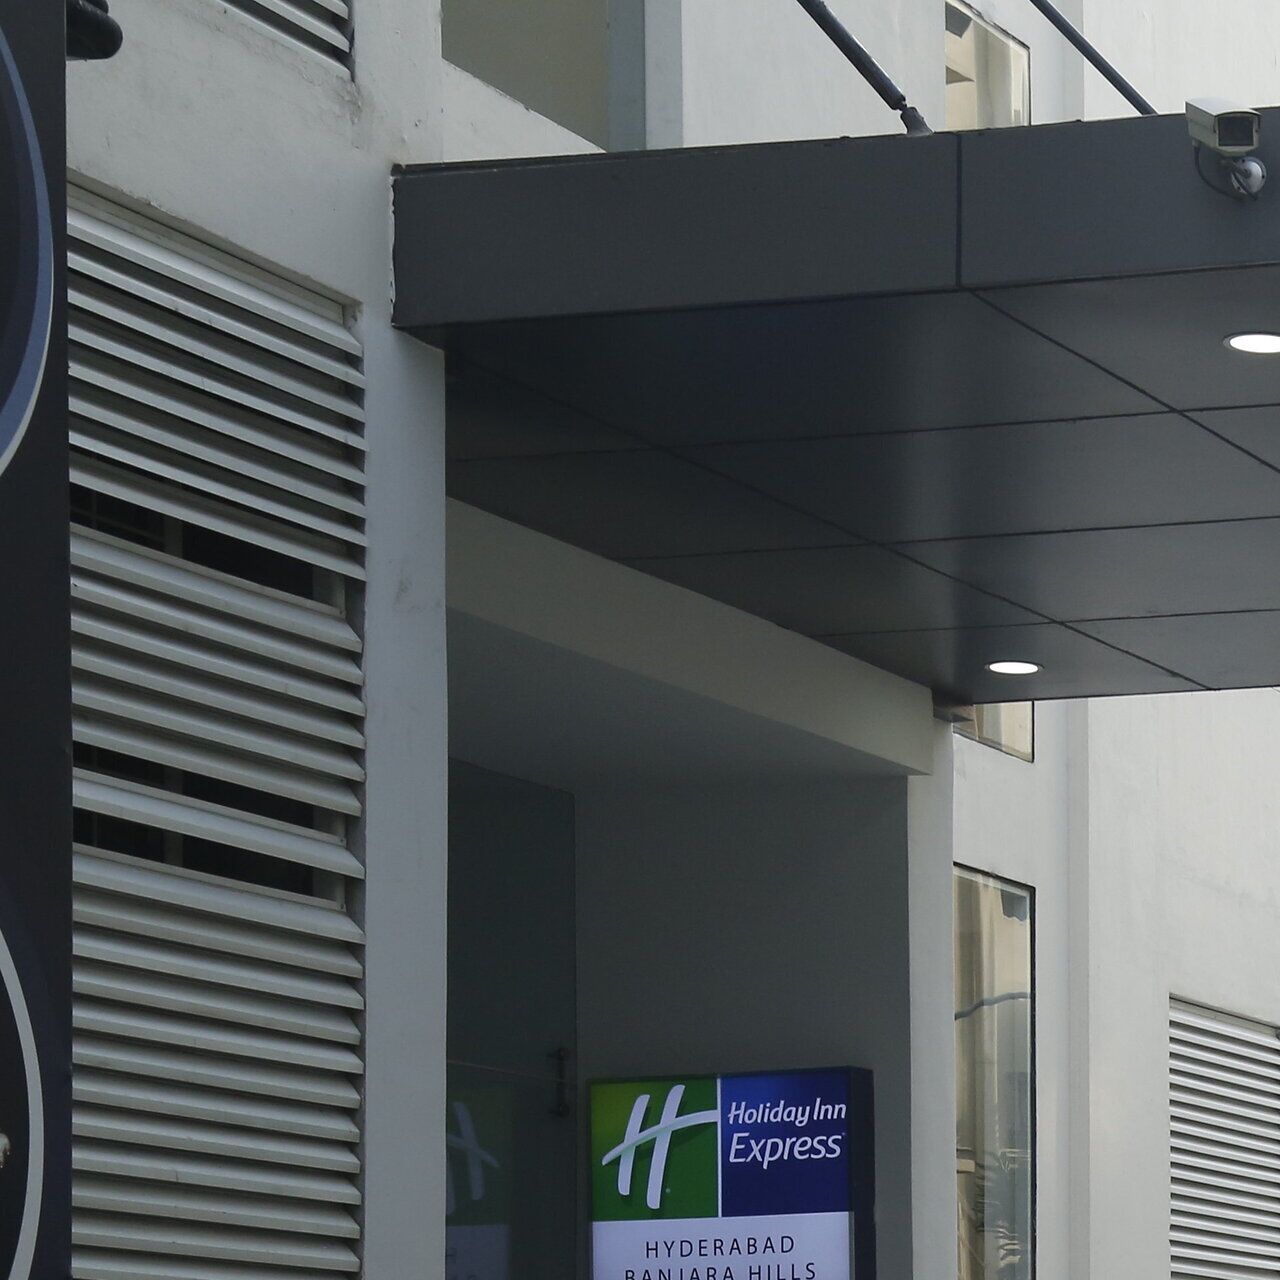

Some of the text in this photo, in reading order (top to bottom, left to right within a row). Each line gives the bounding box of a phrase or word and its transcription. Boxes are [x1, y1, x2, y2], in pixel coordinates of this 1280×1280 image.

[727, 1097, 847, 1127] Holiday Inn
[728, 1132, 842, 1170] Express
[645, 1235, 795, 1259] HYDERABAD
